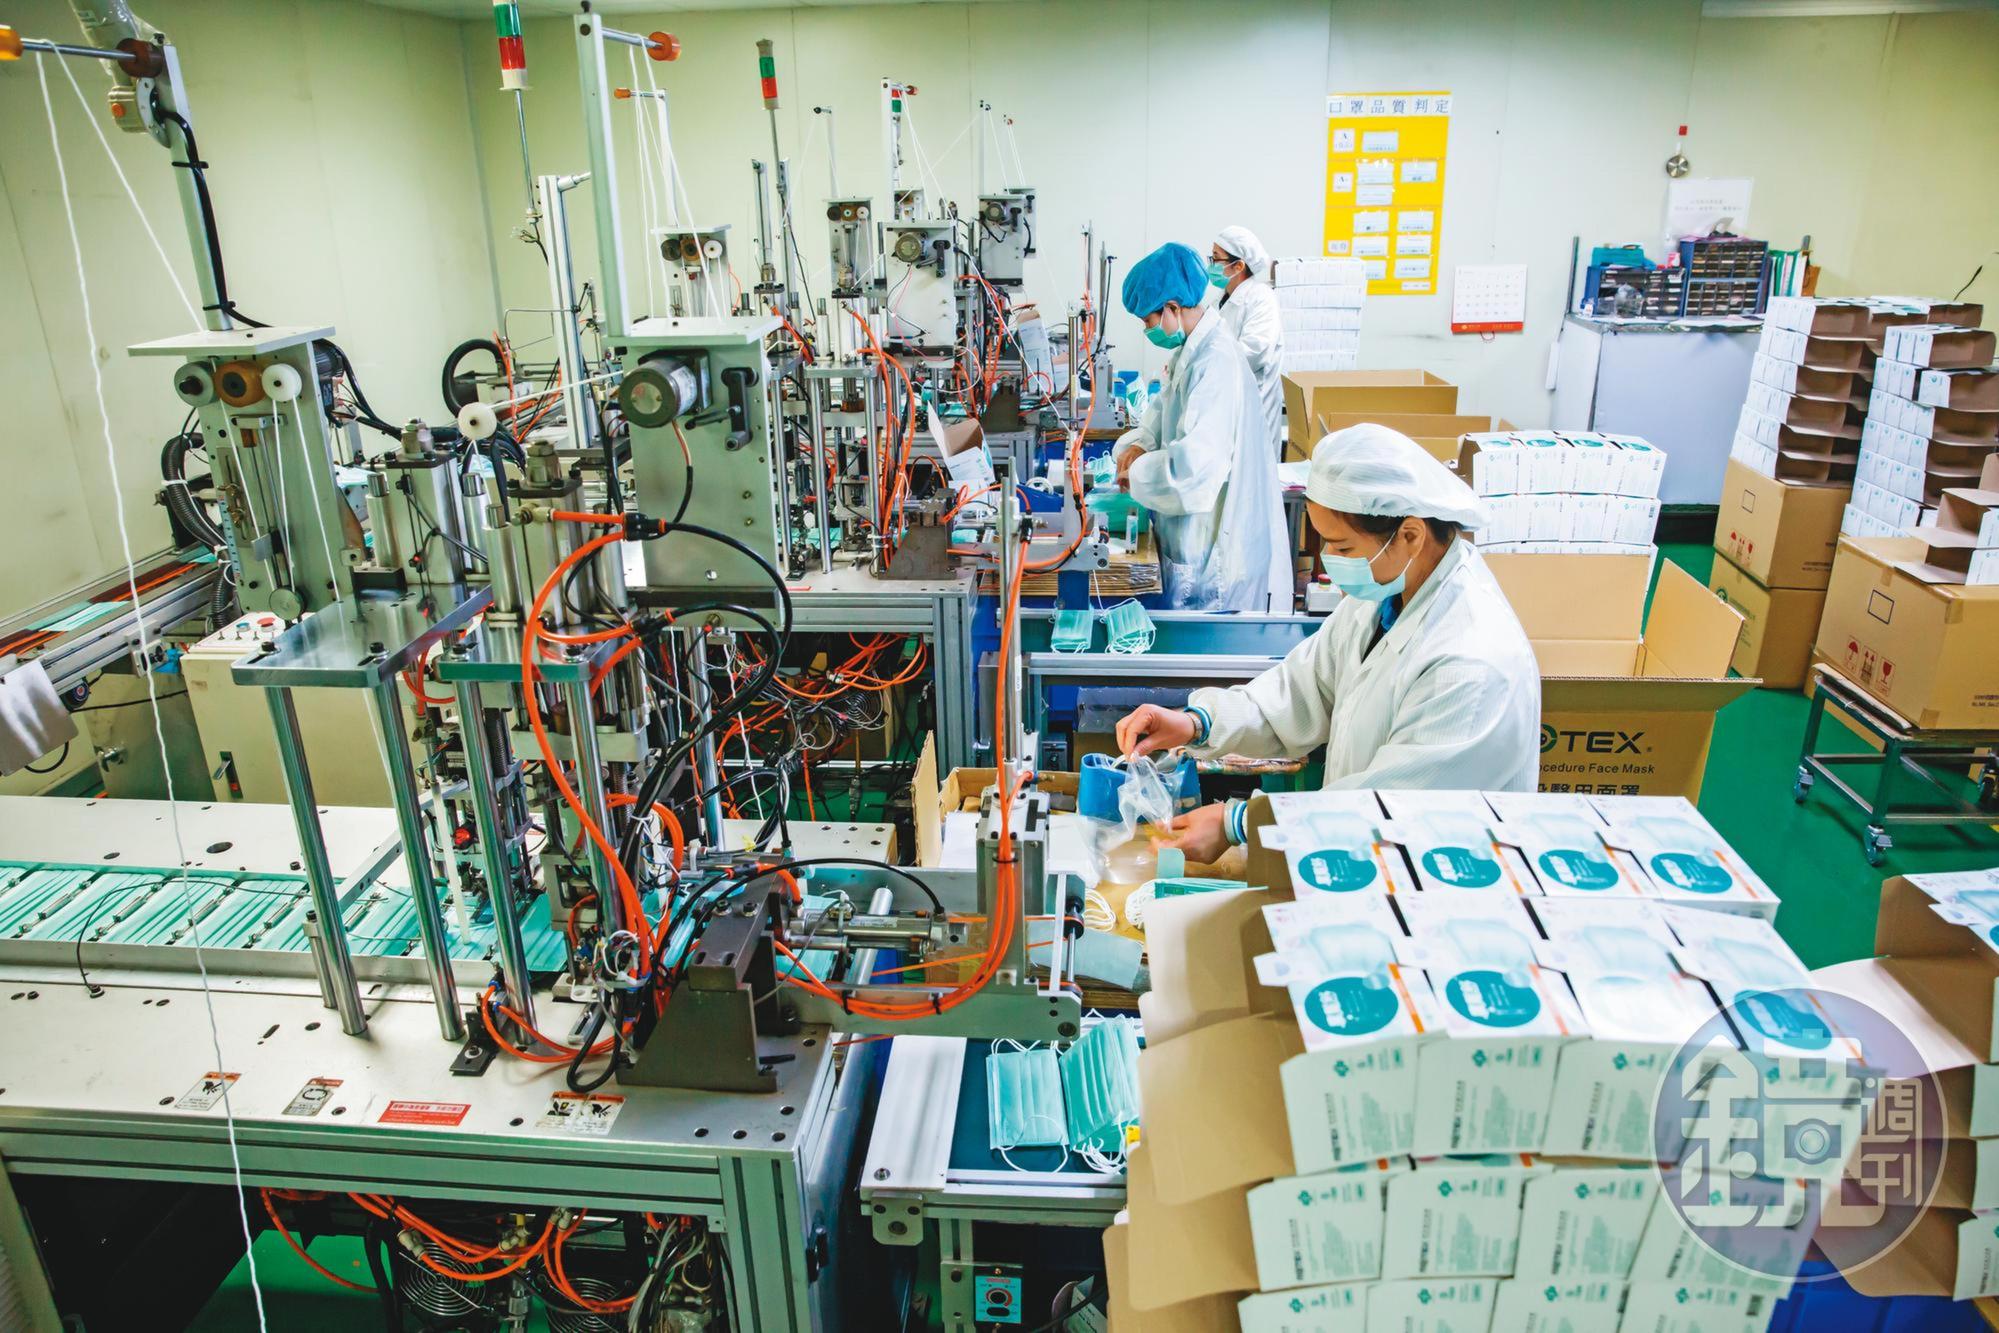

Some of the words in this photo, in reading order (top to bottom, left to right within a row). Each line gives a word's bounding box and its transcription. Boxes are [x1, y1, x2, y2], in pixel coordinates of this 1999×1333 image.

[1330, 99, 1449, 114] 口罩品質判定
[1540, 762, 1585, 774] cedure
[1588, 763, 1619, 774] Face
[1622, 763, 1655, 775] Mask
